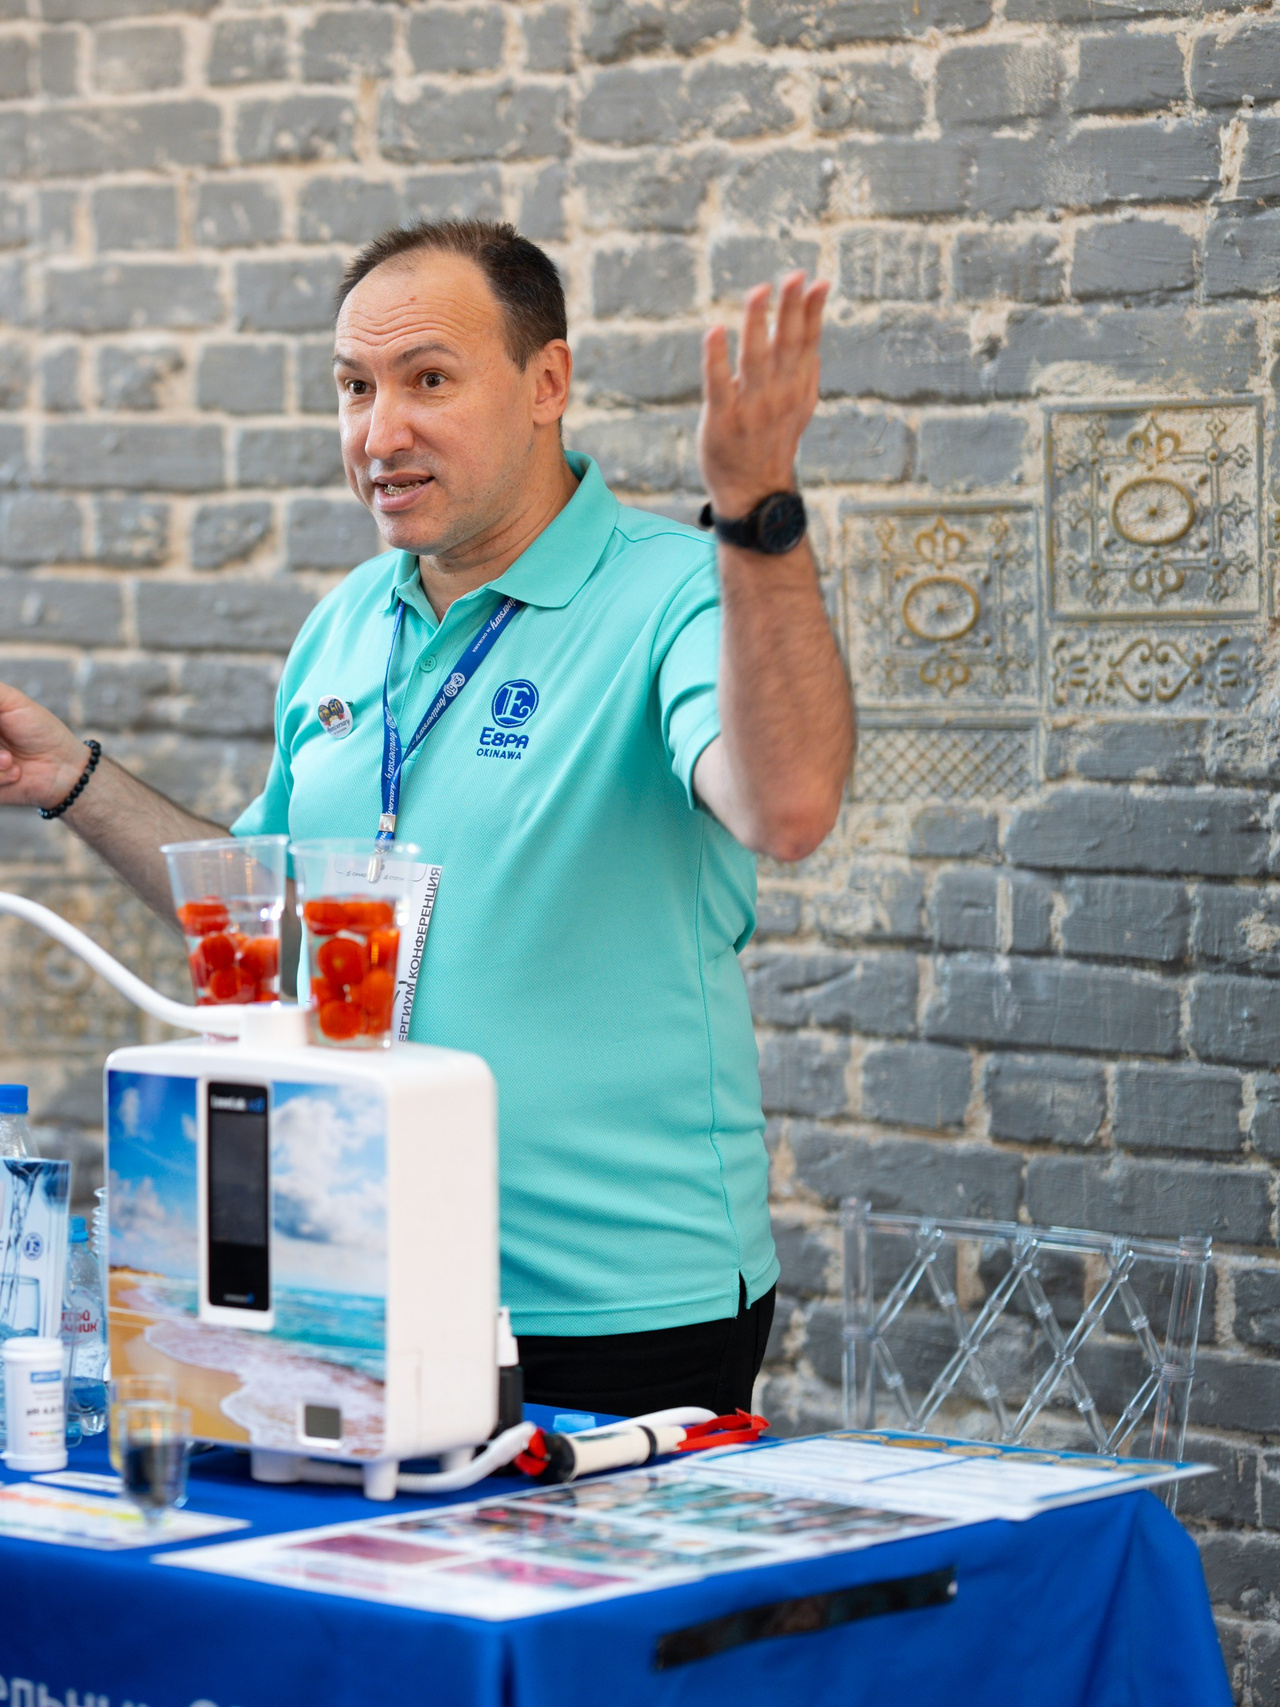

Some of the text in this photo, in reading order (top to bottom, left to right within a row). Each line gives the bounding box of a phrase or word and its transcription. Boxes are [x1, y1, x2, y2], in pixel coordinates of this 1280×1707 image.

[490, 598, 516, 630] iversary
[472, 632, 488, 653] OKINAWA
[416, 694, 447, 742] Anniversary
[384, 730, 398, 780] Anniversary
[477, 748, 522, 760] OKINAWA
[398, 866, 441, 1042] ЕРГИУМ КОНФЕРЕНЦИЯ
